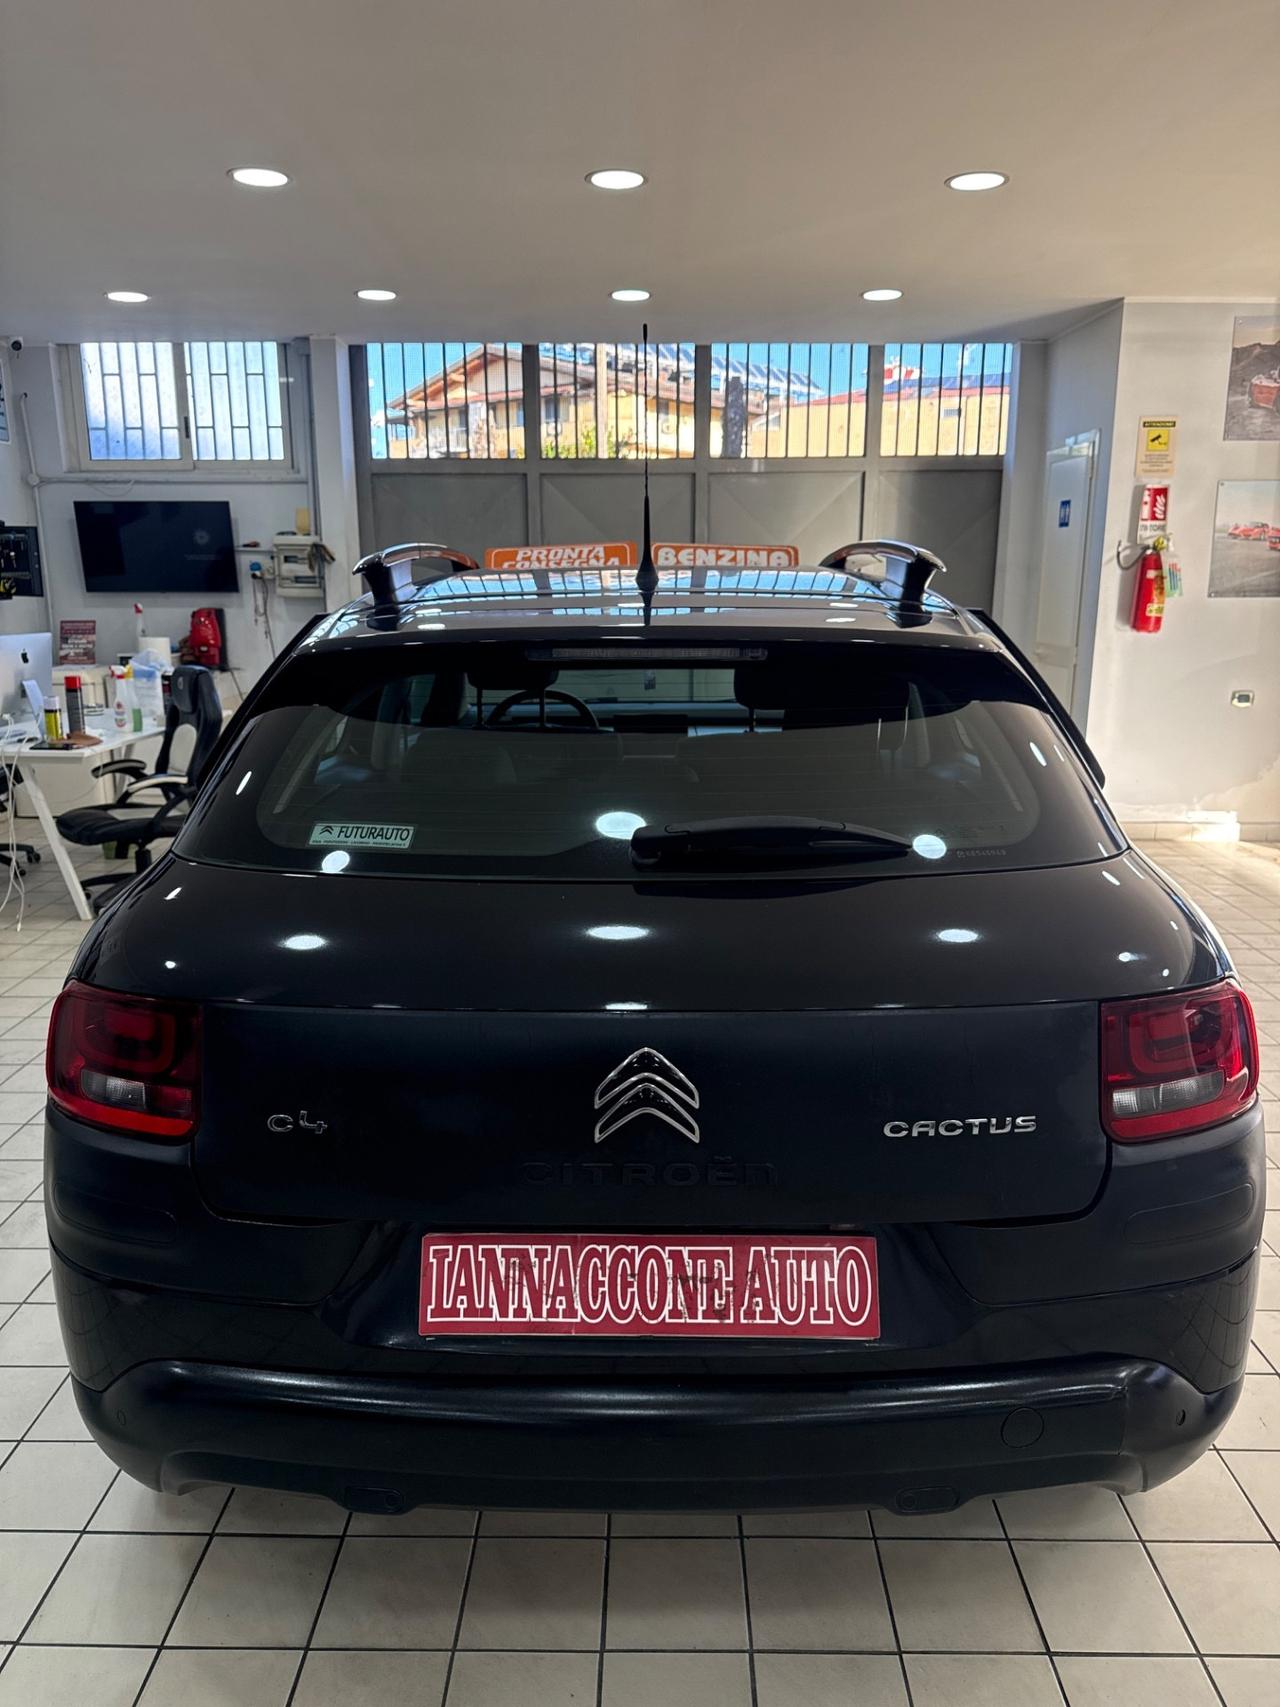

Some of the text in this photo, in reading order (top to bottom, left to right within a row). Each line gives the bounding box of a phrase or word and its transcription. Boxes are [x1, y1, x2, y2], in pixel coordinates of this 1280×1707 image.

[515, 545, 606, 561] PRONTA
[657, 546, 790, 567] BENZINA
[337, 825, 410, 841] FUTURAUTO
[266, 1109, 328, 1135] C4
[883, 1115, 1037, 1139] CACTUS
[427, 1244, 873, 1326] IANNACCONE AUTO
